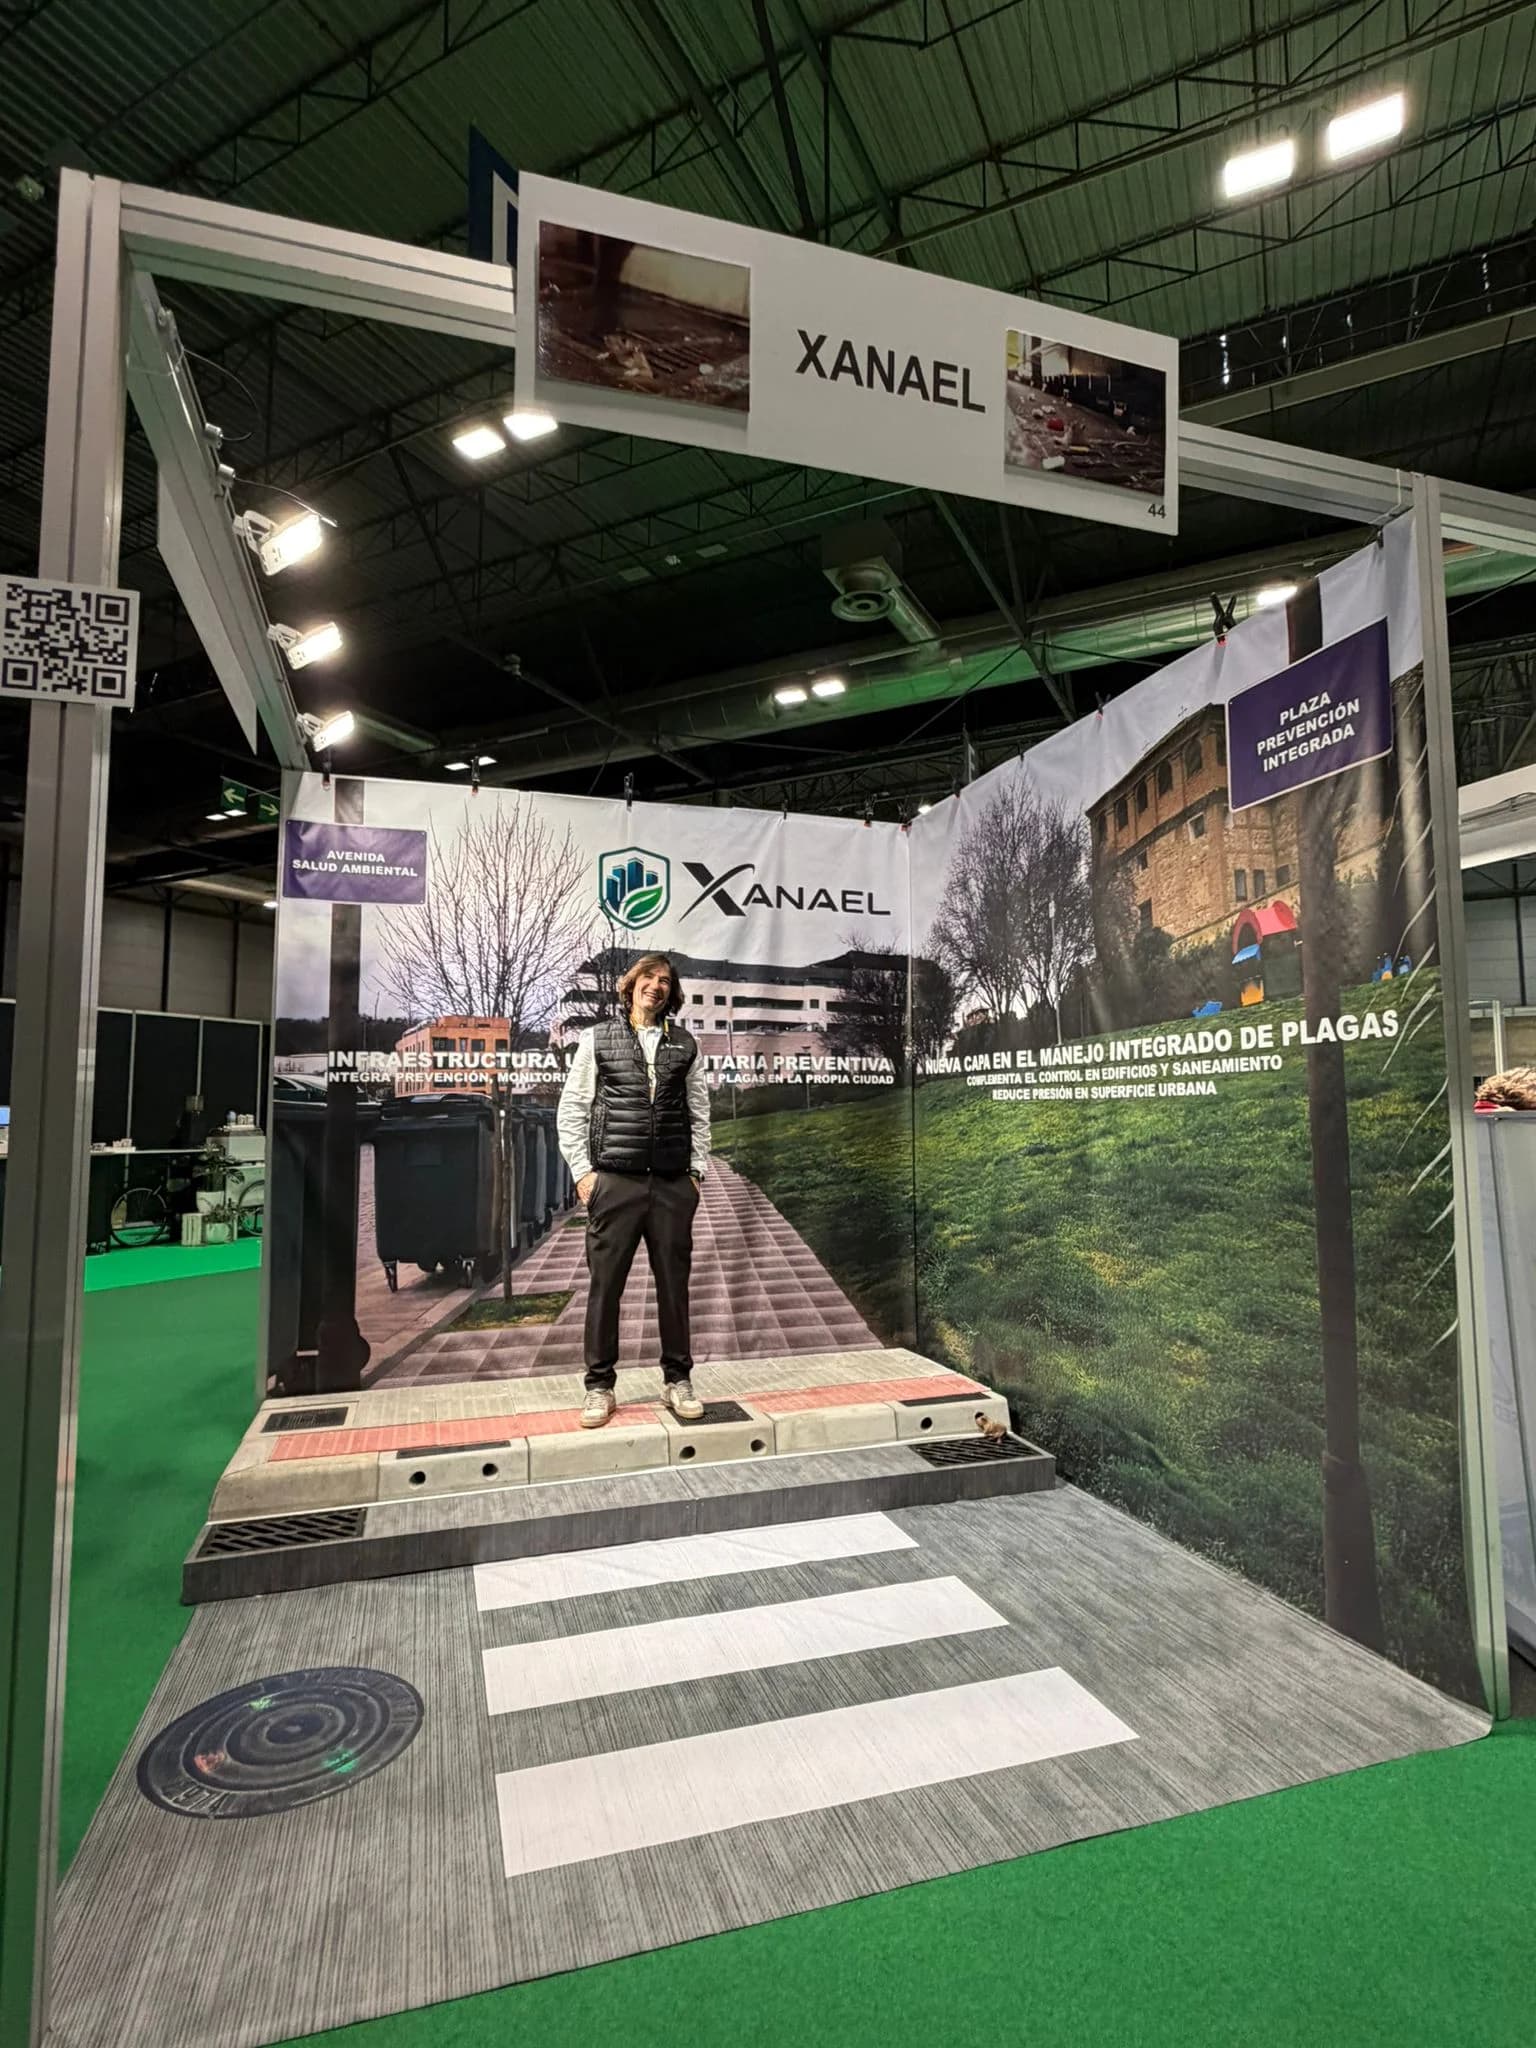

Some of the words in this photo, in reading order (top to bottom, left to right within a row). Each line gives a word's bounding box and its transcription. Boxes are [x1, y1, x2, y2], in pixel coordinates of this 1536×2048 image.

[795, 329, 986, 414] XANAEL
[1147, 503, 1167, 519] 44
[1279, 691, 1332, 726] PLAZA
[1256, 698, 1360, 756] PREVENCIÓN
[1263, 723, 1356, 772] INTEGRADA
[292, 859, 338, 873] SALUD
[341, 864, 418, 877] AMBIENTAL
[327, 850, 386, 863] AVENIDA
[678, 861, 891, 923] XANAEL
[925, 1057, 962, 1075] NUEVA
[964, 1053, 991, 1072] CAPA
[992, 1051, 1012, 1069] EN
[1015, 1049, 1037, 1068] EL
[1040, 1043, 1104, 1067] MANEJO
[1109, 1028, 1233, 1062] INTEGRADO
[1240, 1024, 1274, 1050] DE
[1281, 1009, 1399, 1046] PLAGAS
[328, 1051, 559, 1069] INFRAESTRUCTURA
[704, 1055, 769, 1071] ITARIA
[773, 1055, 892, 1072] PREVENTIVA
[1024, 1071, 1037, 1084] EL
[1039, 1069, 1083, 1083] CONTROL
[1085, 1068, 1100, 1081] EN
[1102, 1064, 1158, 1080] EDIFICIOS
[1160, 1062, 1169, 1077] Y
[1172, 1054, 1283, 1076] SANEAMIENTO
[395, 1070, 493, 1084] PREVENCIÓN,
[497, 1072, 568, 1083] MONITORI
[718, 1073, 765, 1084] PLAGAS
[768, 1073, 783, 1084] EN
[787, 1073, 803, 1084] LA
[806, 1074, 850, 1085] PROPIA
[852, 1074, 895, 1085] CIUDAD
[992, 1088, 1030, 1100] REDUCE
[1032, 1086, 1073, 1100] PRESIÓN
[1075, 1086, 1088, 1099] EN
[1090, 1084, 1156, 1099] SUPERFICIE
[1158, 1080, 1218, 1097] URBANA
